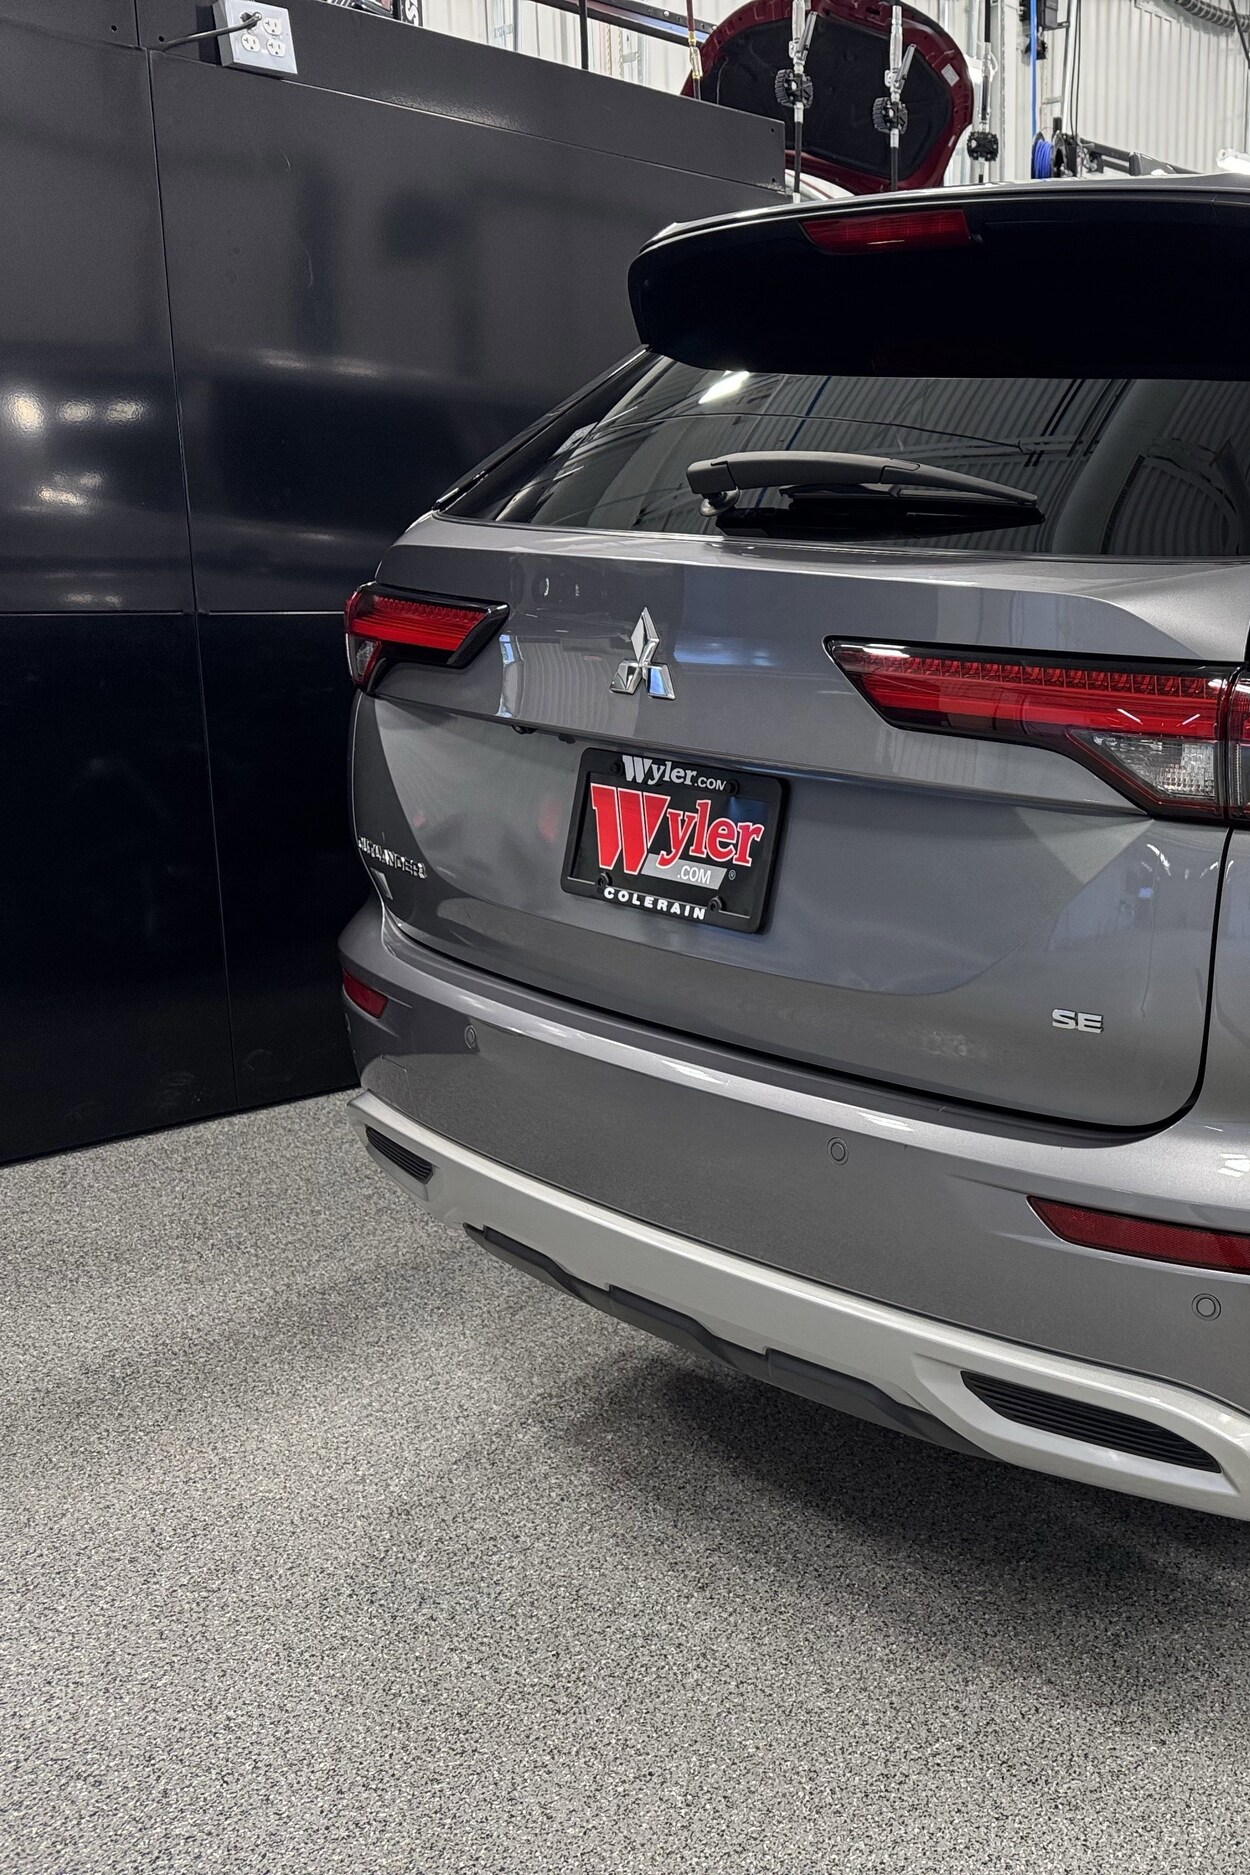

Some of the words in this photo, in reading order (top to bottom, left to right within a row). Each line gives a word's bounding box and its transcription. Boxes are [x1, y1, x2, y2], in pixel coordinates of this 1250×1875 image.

[590, 782, 765, 876] Wyler
[677, 865, 712, 885] .COM
[603, 887, 706, 921] COLERAIN
[1051, 1008, 1104, 1034] SE
